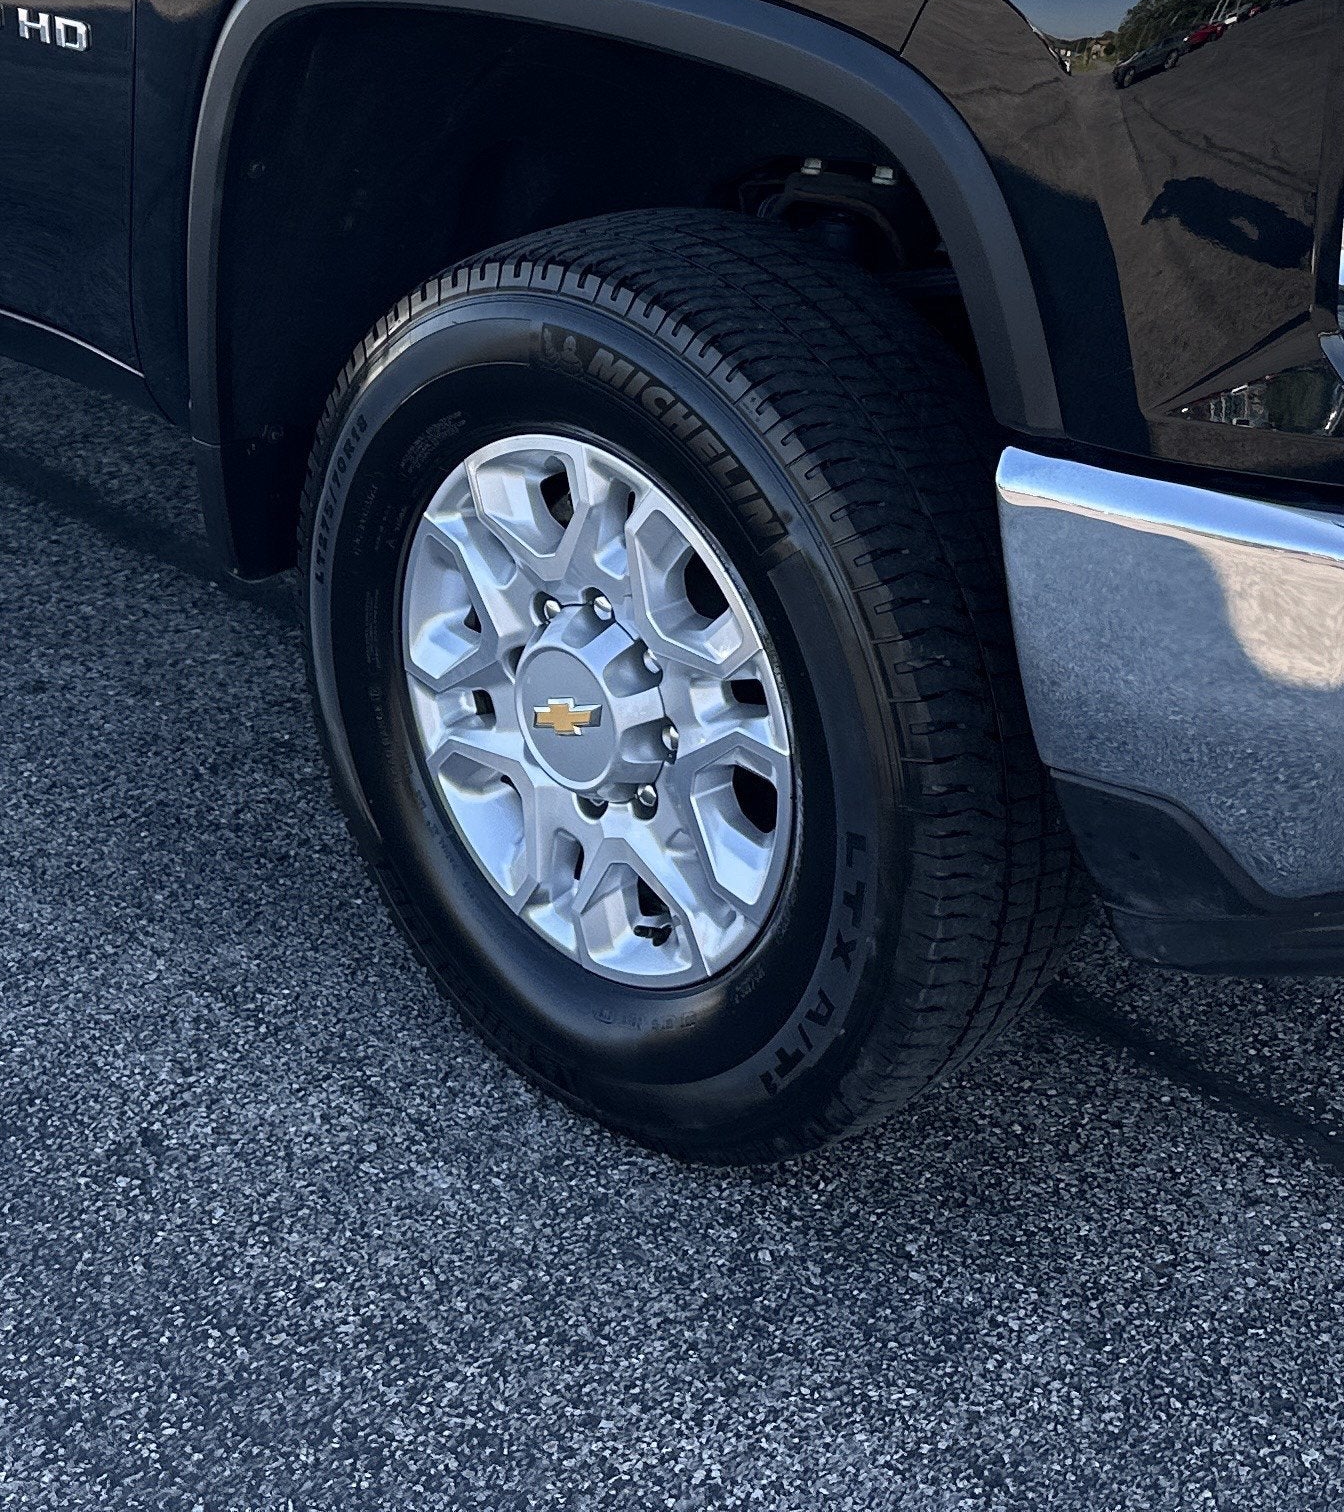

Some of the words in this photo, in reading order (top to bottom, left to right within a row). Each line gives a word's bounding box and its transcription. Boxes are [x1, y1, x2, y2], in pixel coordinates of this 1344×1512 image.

[17, 6, 92, 52] HD
[589, 347, 787, 544] MICHELIN
[831, 831, 866, 969] LTX
